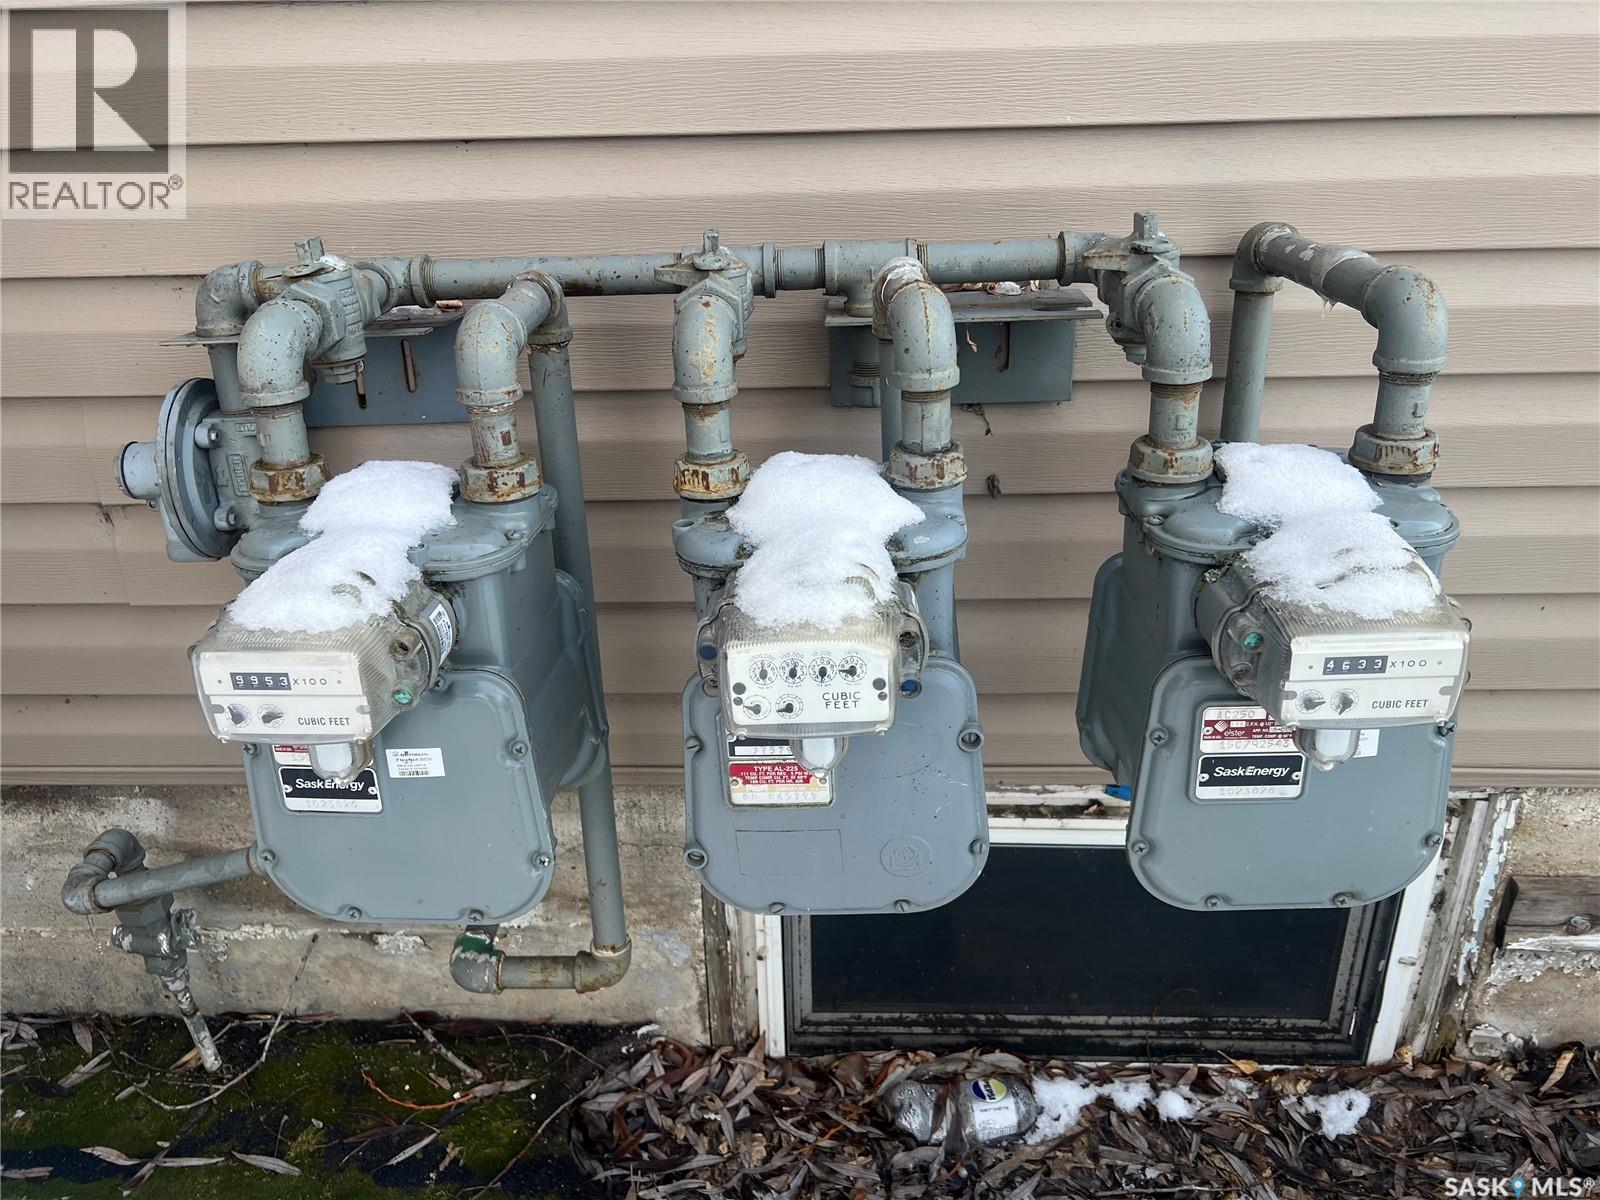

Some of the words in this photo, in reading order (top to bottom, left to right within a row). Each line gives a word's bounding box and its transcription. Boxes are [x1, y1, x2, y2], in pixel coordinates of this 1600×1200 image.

[1325, 659, 1382, 672] 4633
[234, 675, 289, 687] 9953
[822, 691, 861, 700] CUBIC
[825, 700, 858, 709] FEET
[1371, 700, 1402, 709] CUBIC
[1404, 699, 1429, 708] FEET
[297, 717, 326, 726] CUBIC
[329, 717, 350, 726] FEET
[1213, 766, 1290, 778] SaskEnergy
